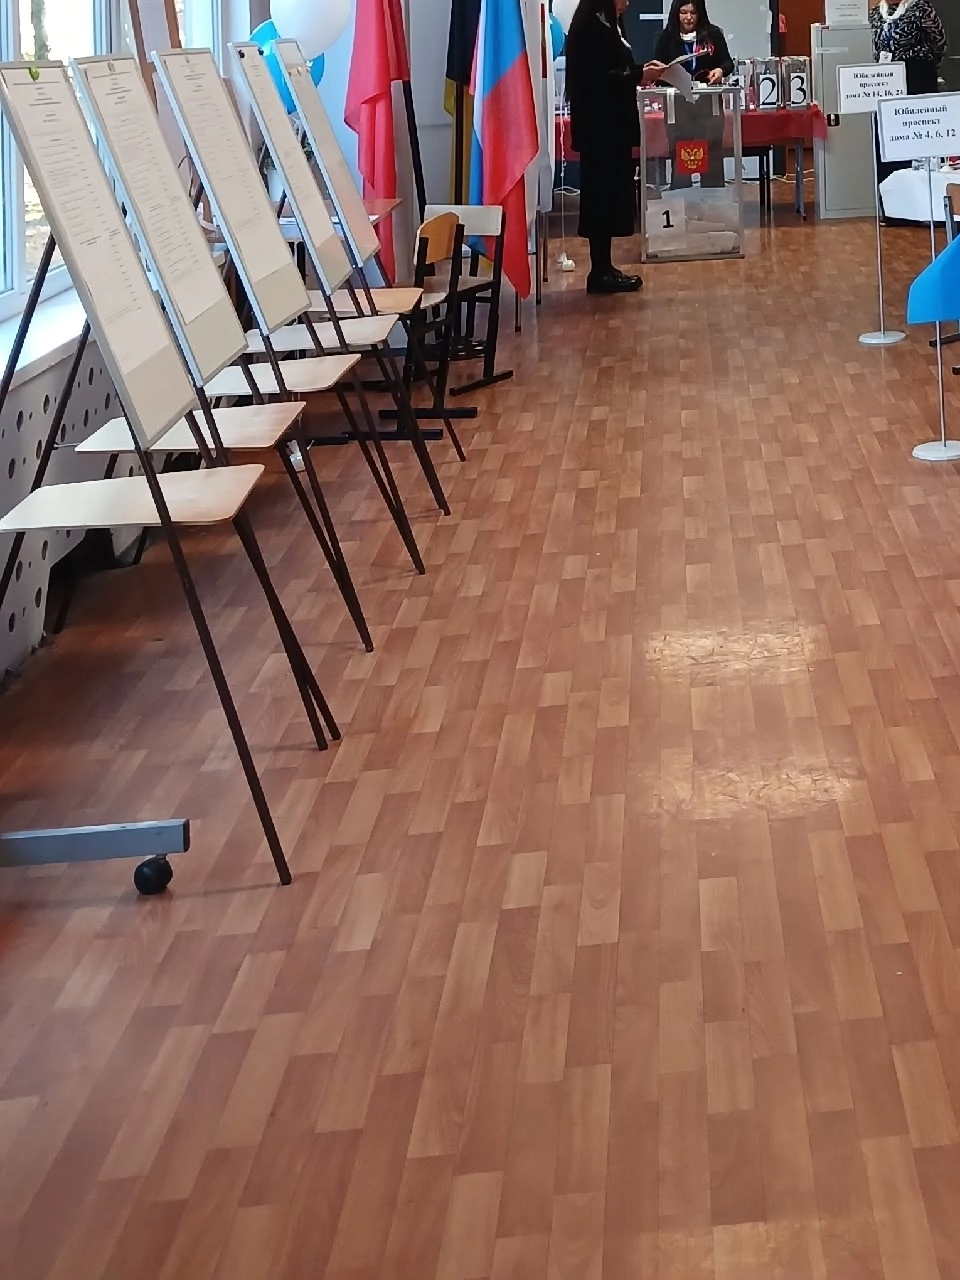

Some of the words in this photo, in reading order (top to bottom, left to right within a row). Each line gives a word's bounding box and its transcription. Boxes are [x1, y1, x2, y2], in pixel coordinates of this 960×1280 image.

[759, 76, 777, 106] 2
[791, 75, 807, 105] 3
[894, 105, 948, 116] Юбилейный
[902, 118, 941, 129] проспект
[889, 134, 910, 142] дома
[911, 131, 923, 140] №
[924, 130, 934, 139] 4,
[946, 128, 957, 137] 12
[662, 209, 675, 229] 1
